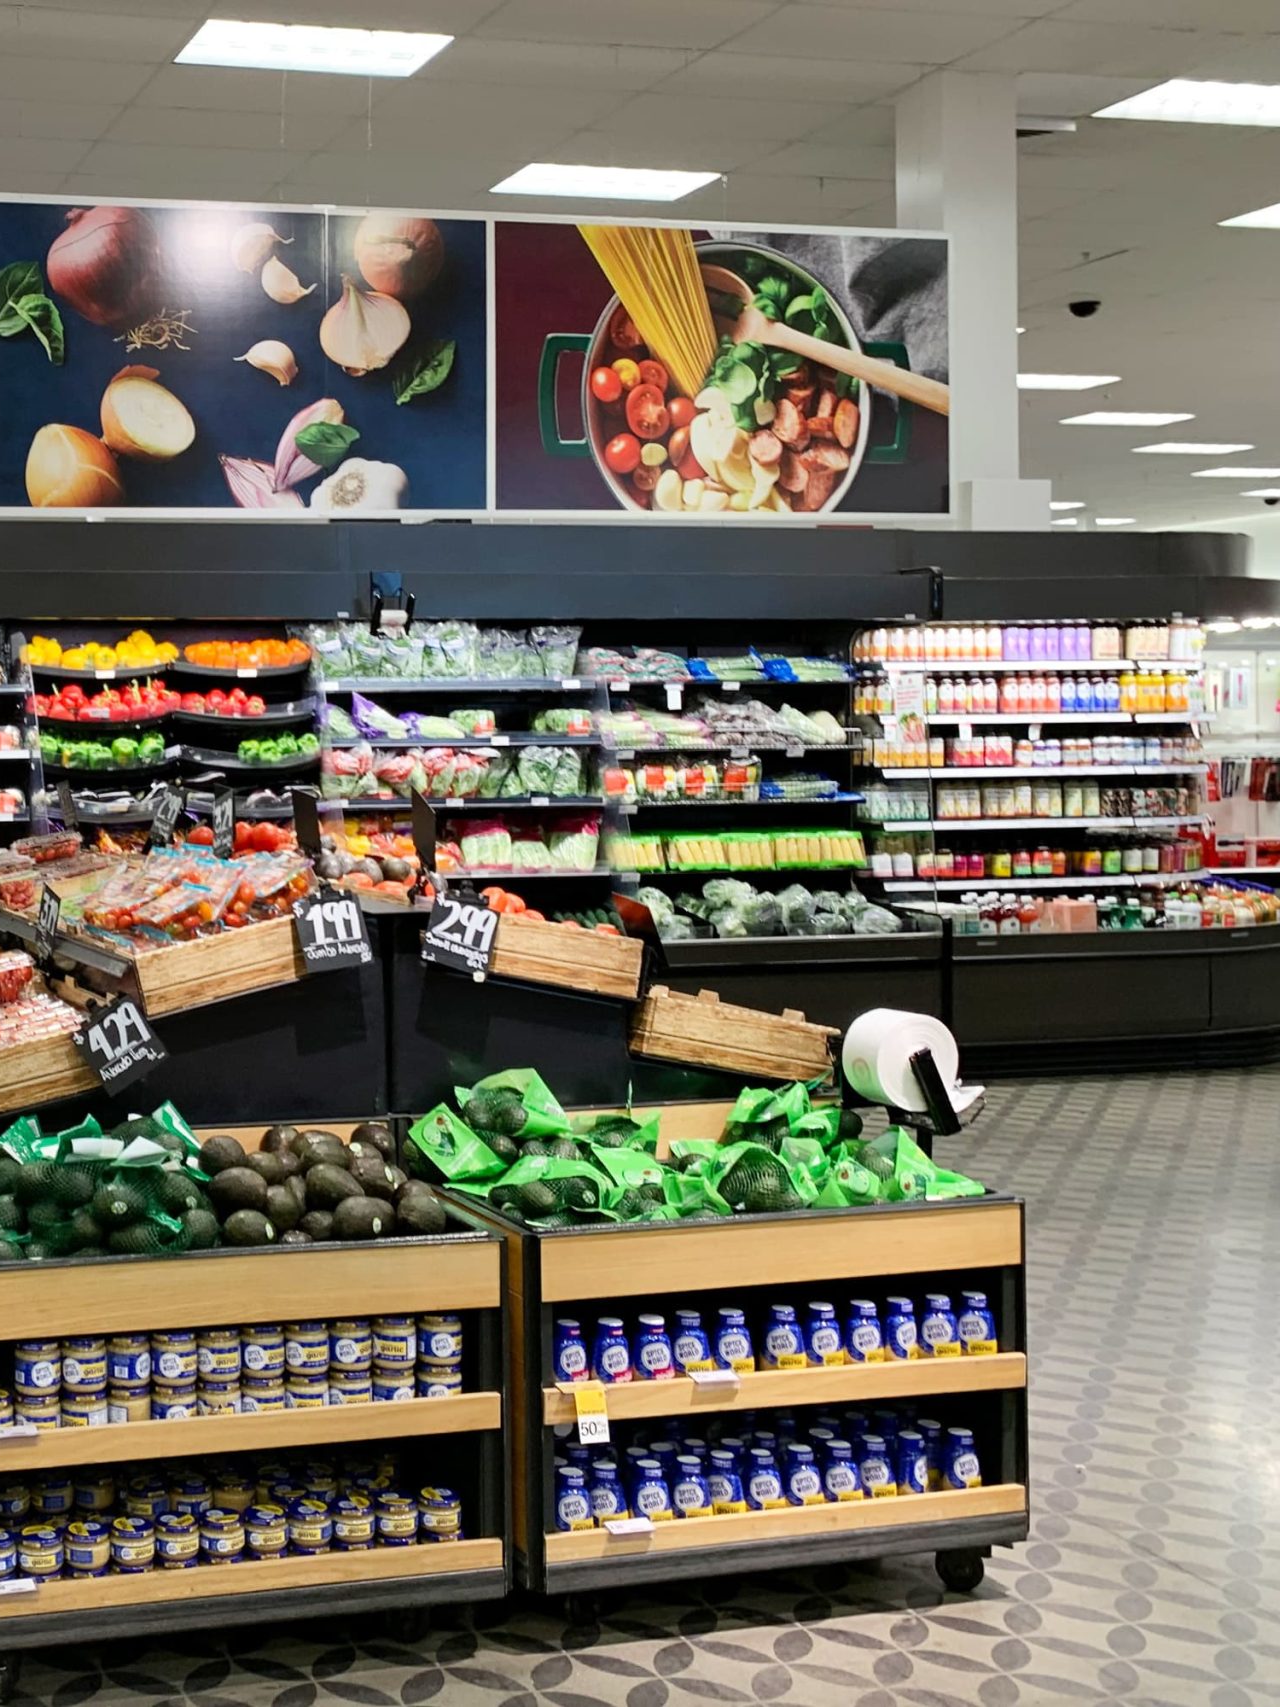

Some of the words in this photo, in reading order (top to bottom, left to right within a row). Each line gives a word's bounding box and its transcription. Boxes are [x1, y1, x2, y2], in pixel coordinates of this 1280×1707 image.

[304, 945, 337, 959] Jumbo
[678, 1342, 695, 1351] SPICE
[724, 1340, 742, 1348] SPICE
[679, 1348, 699, 1358] WORLD
[581, 1422, 597, 1436] 50
[754, 1480, 773, 1489] SPICE
[641, 1491, 660, 1501] SPICE
[678, 1489, 696, 1498] SPICE
[756, 1486, 776, 1497] WORLD
[563, 1500, 581, 1509] SPICE
[643, 1498, 664, 1509] WORLD
[679, 1495, 700, 1505] WORLD
[564, 1507, 584, 1517] WORLD
